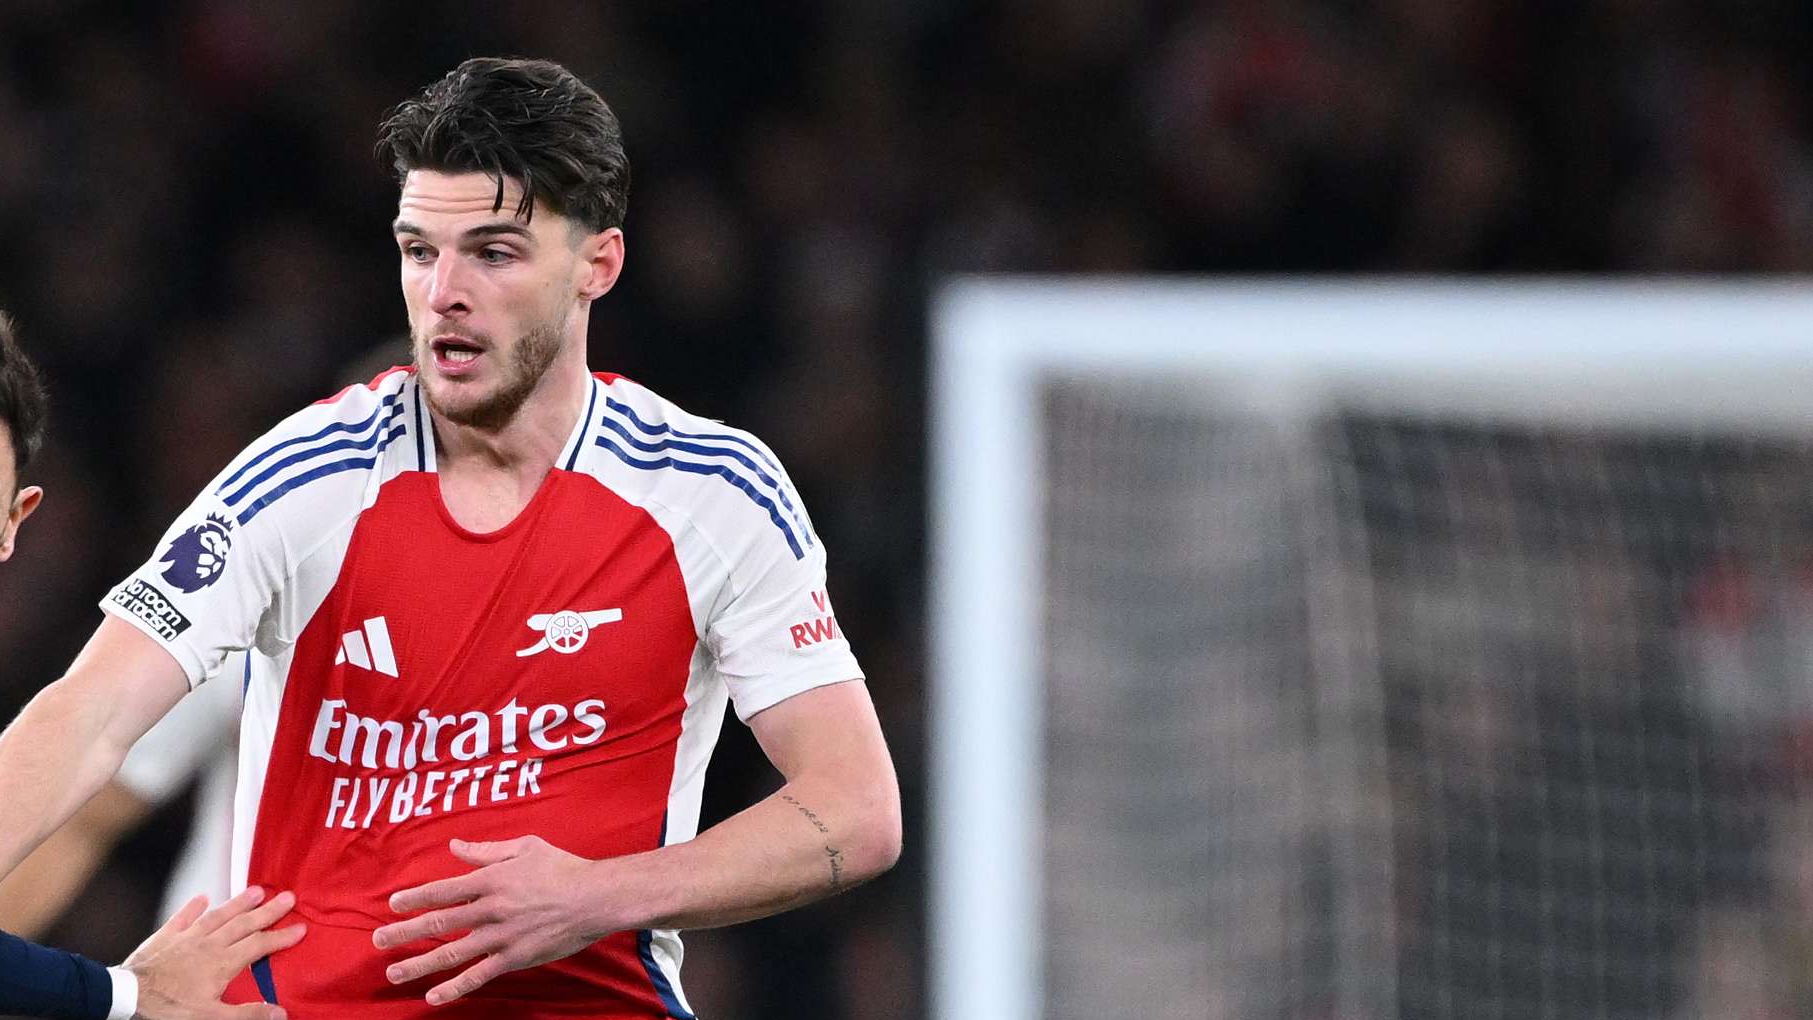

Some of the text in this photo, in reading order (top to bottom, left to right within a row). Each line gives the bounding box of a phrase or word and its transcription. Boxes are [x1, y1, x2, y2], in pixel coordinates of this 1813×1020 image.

[127, 598, 178, 642] racism
[139, 587, 182, 627] room
[309, 697, 607, 770] Emirates
